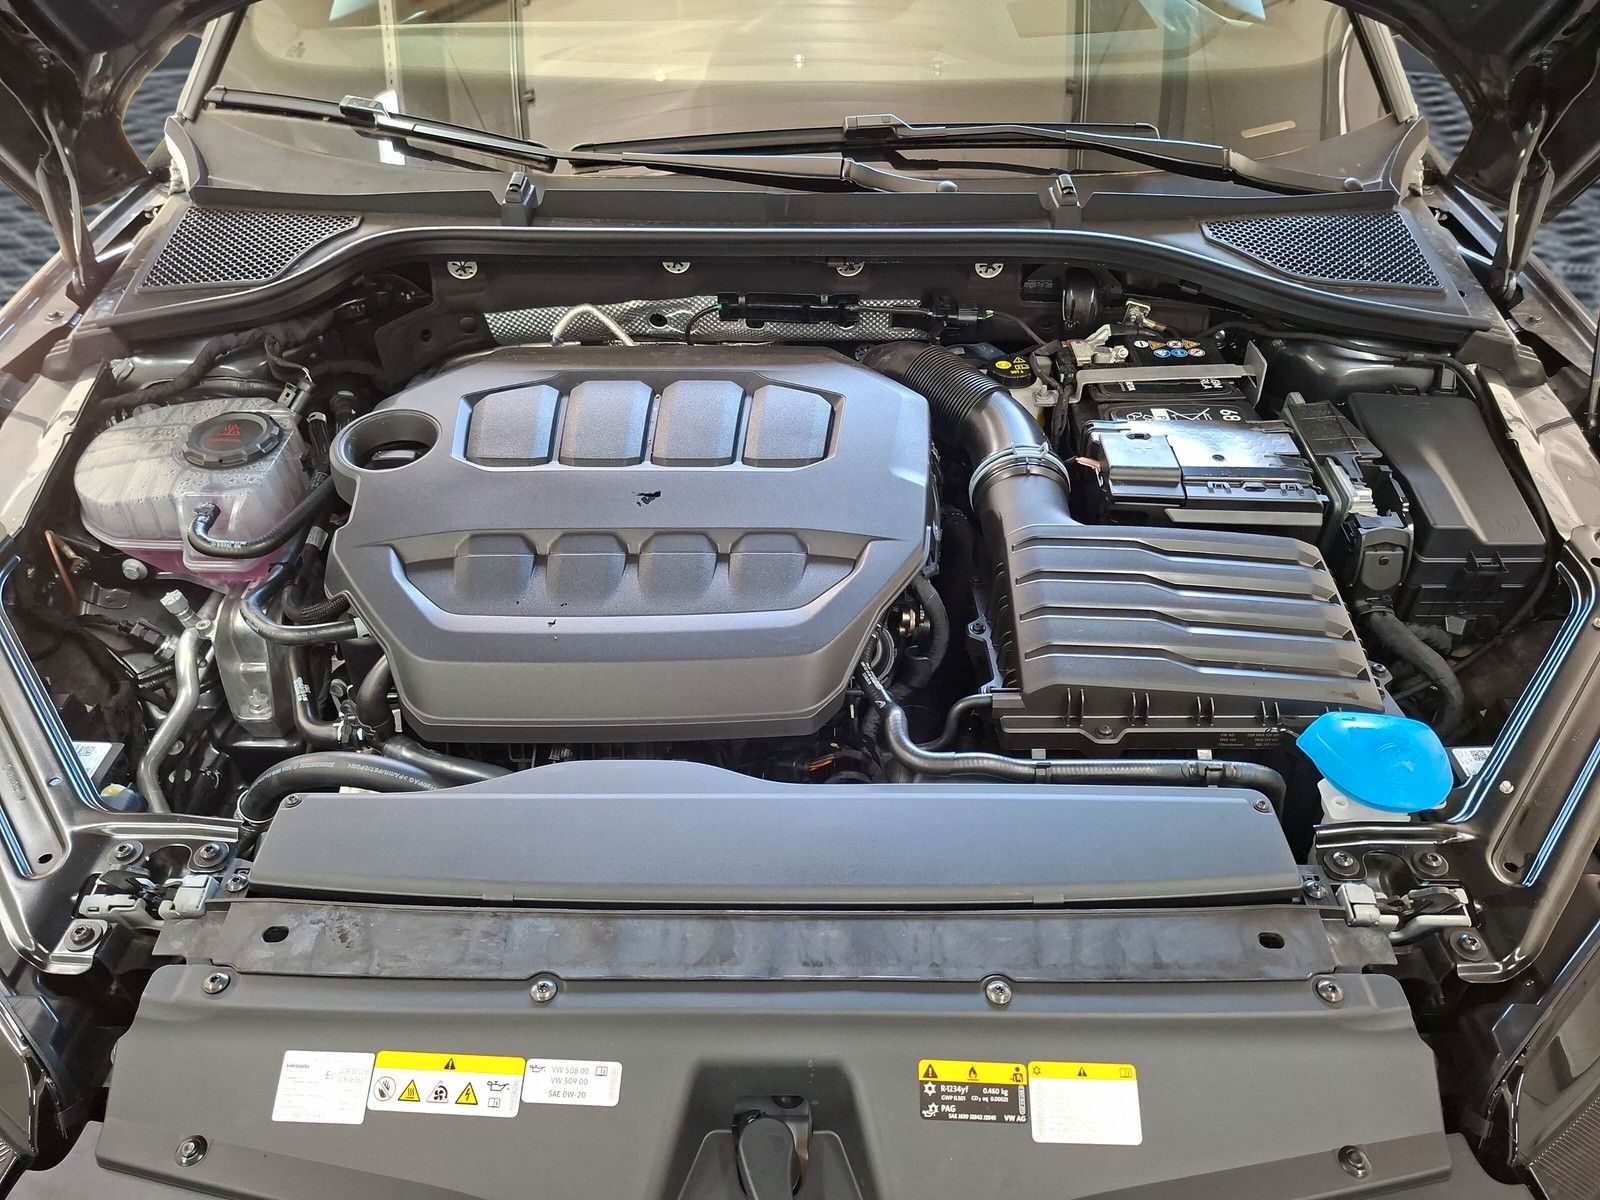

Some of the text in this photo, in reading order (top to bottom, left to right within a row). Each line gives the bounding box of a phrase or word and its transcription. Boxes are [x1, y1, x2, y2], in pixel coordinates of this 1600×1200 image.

[580, 1067, 590, 1075] 00
[550, 1076, 589, 1086] VW 509 00
[548, 1089, 587, 1099] SAE 0W-20
[940, 1084, 1009, 1097] R-1234yf 0.460 kg
[940, 1104, 956, 1112] PAG
[1003, 1114, 1016, 1122] VW
